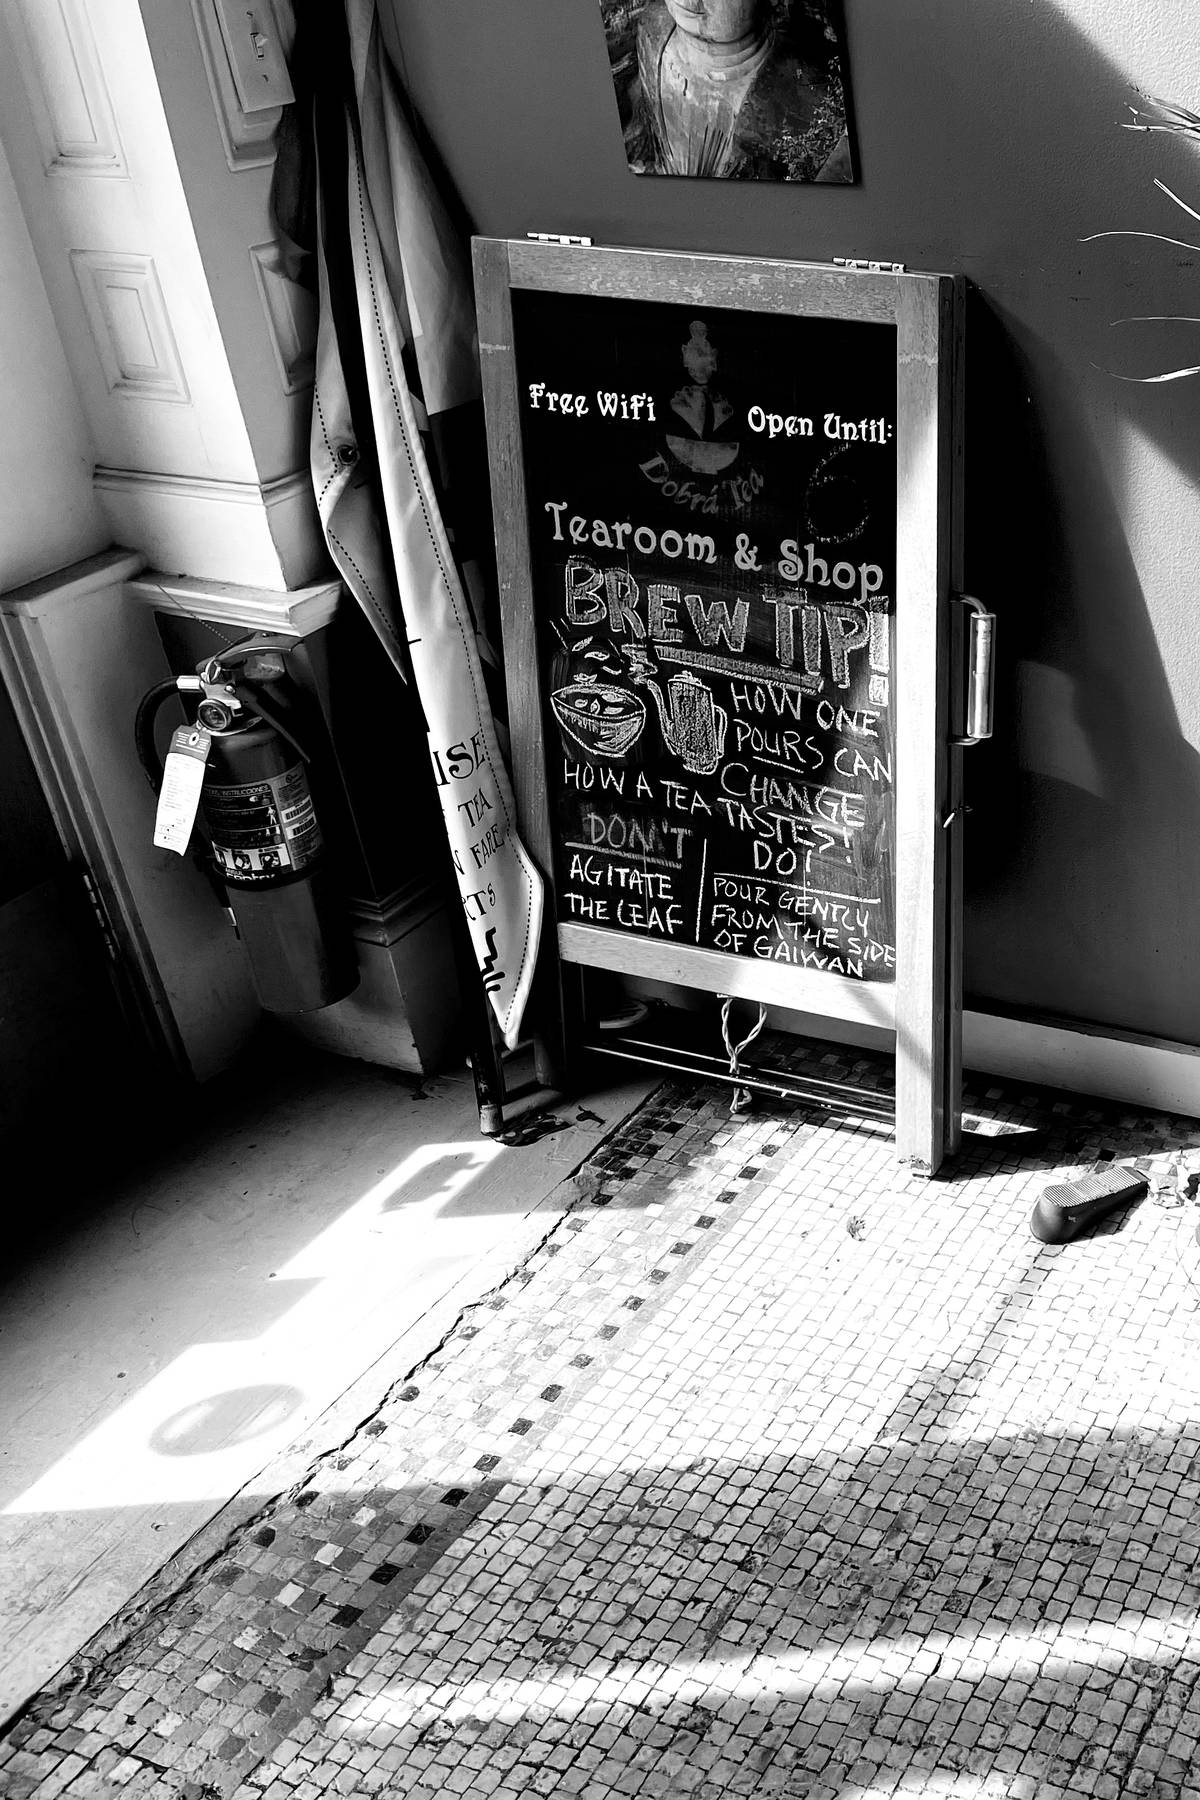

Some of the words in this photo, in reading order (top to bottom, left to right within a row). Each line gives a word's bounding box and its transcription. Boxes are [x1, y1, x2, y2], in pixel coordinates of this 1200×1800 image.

[529, 383, 589, 418] Free
[597, 390, 656, 422] WiFi
[748, 405, 814, 439] Open
[823, 413, 893, 444] Until:
[722, 467, 765, 511] Tea
[545, 501, 718, 565] Tearoom
[734, 533, 763, 572] &
[778, 538, 884, 604] Shop
[565, 555, 750, 652] BREW
[730, 681, 802, 721] HOW
[816, 699, 881, 737] ONE
[733, 718, 824, 770] POURS
[834, 747, 893, 784] CAN
[457, 787, 493, 828] TEA
[563, 760, 624, 795] HOW
[636, 771, 654, 800] A
[660, 780, 711, 817] TEA
[720, 761, 866, 828] CHANGE
[470, 823, 505, 869] FARE
[583, 811, 695, 859] DON'T
[753, 840, 813, 890] DO!
[569, 854, 674, 901] AGITATE
[565, 893, 610, 921] THE
[618, 898, 684, 935] LEAF
[713, 877, 769, 905] POUR
[779, 889, 870, 935] GENTLY
[711, 904, 779, 937] FROM
[787, 918, 842, 951] THE
[848, 935, 897, 968] SIDE
[714, 930, 744, 955] OF
